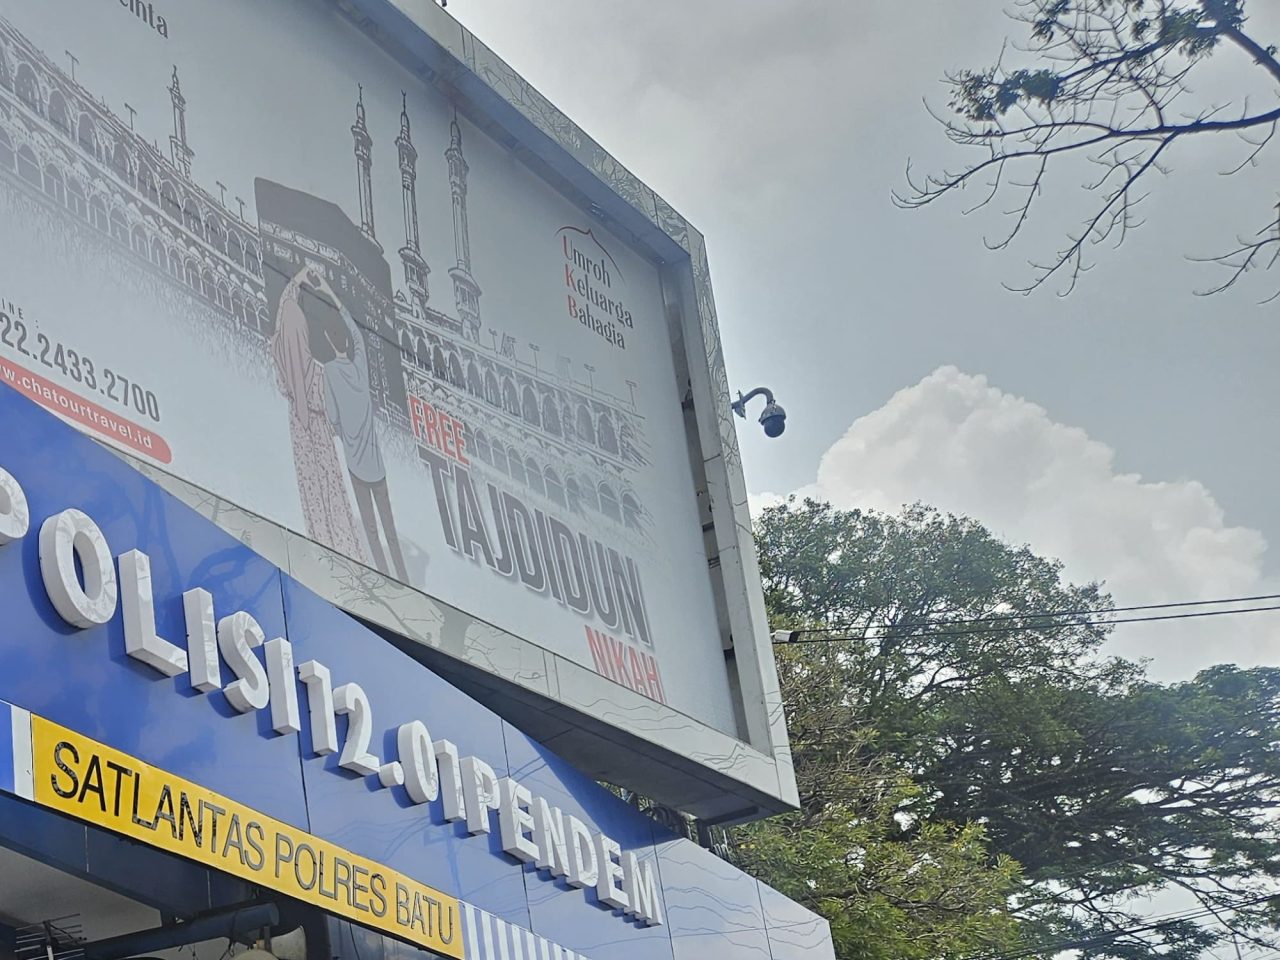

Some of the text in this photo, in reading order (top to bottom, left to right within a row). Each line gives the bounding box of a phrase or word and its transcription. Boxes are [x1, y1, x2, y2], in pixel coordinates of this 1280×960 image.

[119, 0, 168, 39] nta
[563, 234, 611, 288] Umroh
[565, 263, 634, 328] Keluarga
[567, 294, 626, 350] Bahagia
[410, 396, 470, 467] FREE
[418, 445, 651, 647] TAJDIDUN
[584, 624, 665, 705] NIKAH
[297, 659, 467, 823] 12.01
[458, 755, 664, 927] PENDEM
[50, 741, 454, 945] SATLANTAS POLRES BATU
